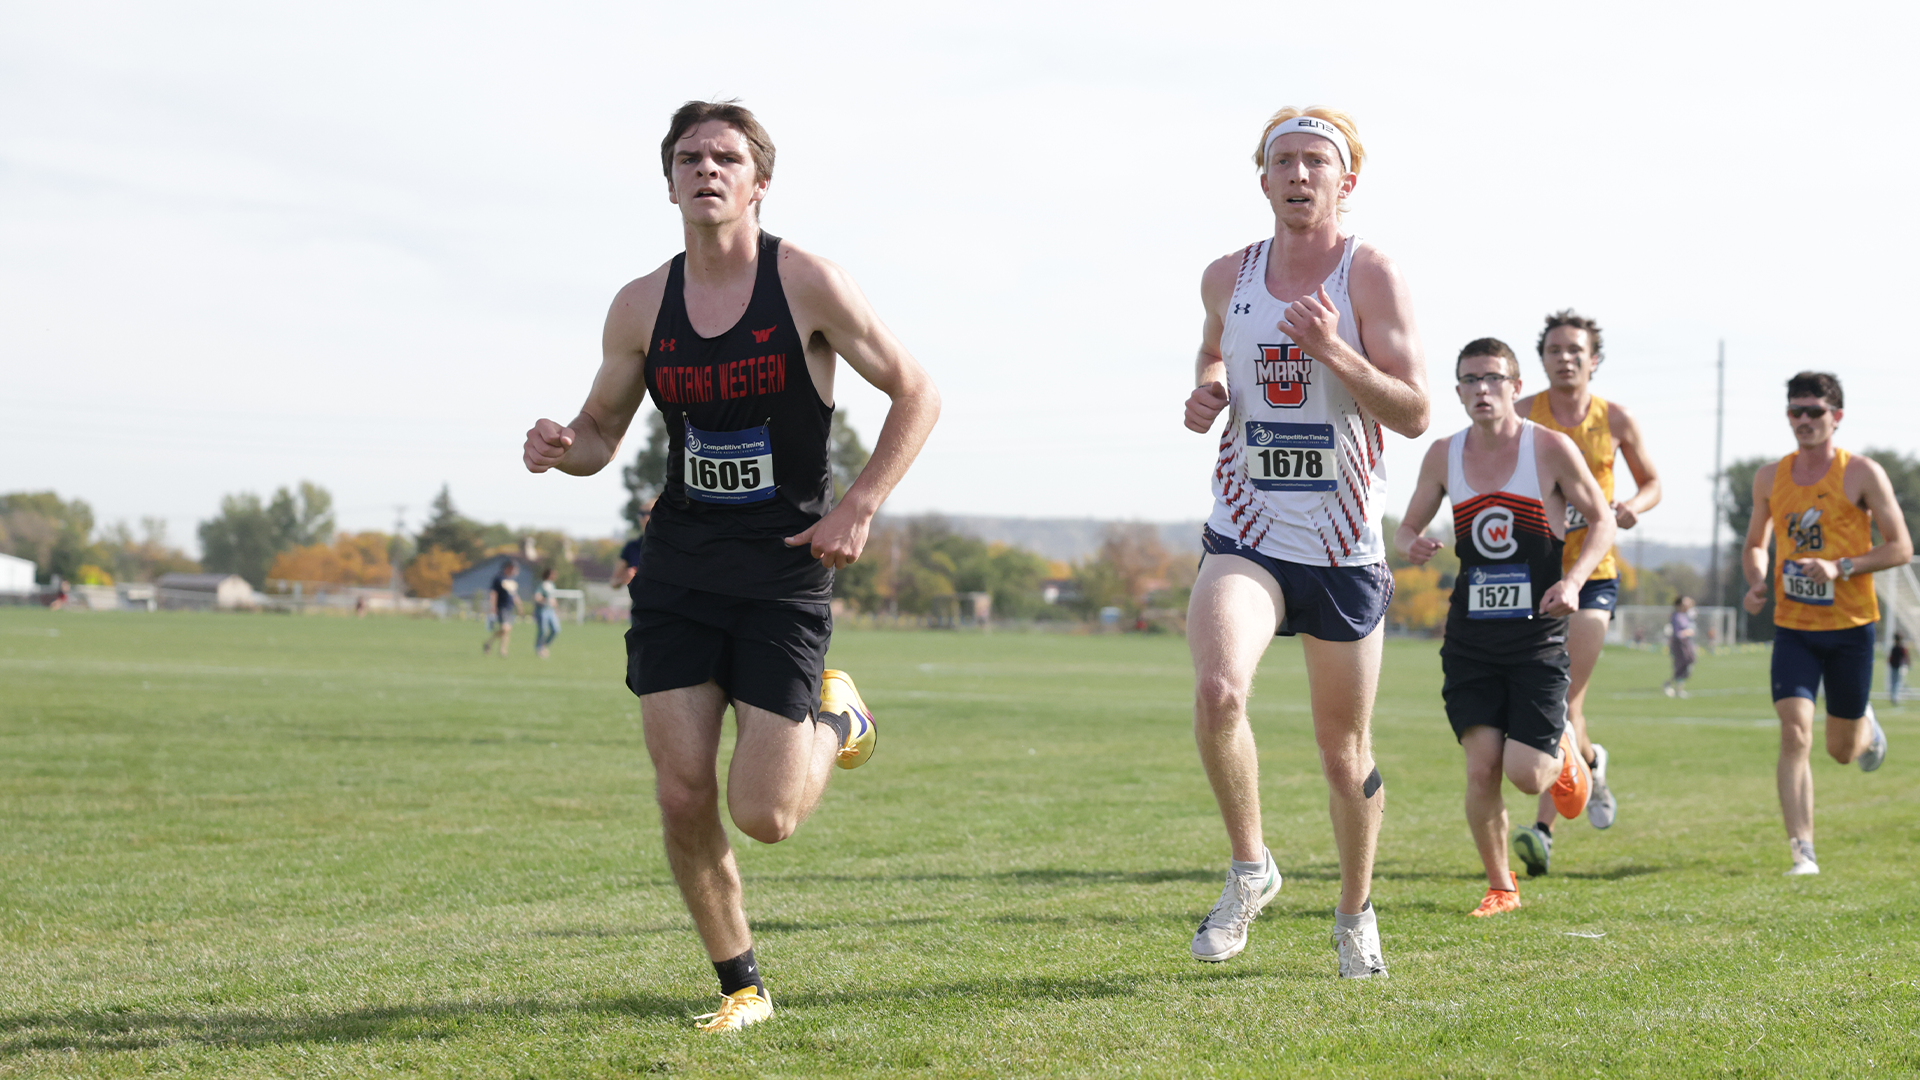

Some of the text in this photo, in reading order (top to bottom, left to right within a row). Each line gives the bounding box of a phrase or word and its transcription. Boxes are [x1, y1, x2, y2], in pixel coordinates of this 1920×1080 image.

[718, 353, 786, 400] WESTERN
[1254, 359, 1312, 385] MARY
[702, 441, 765, 452] Competitive Timing
[1274, 433, 1309, 441] Competitive
[1308, 434, 1329, 442] Timing
[689, 456, 761, 491] 1605
[1258, 449, 1323, 478] 1678
[1477, 586, 1520, 608] 1527
[1788, 577, 1827, 597] 1630
